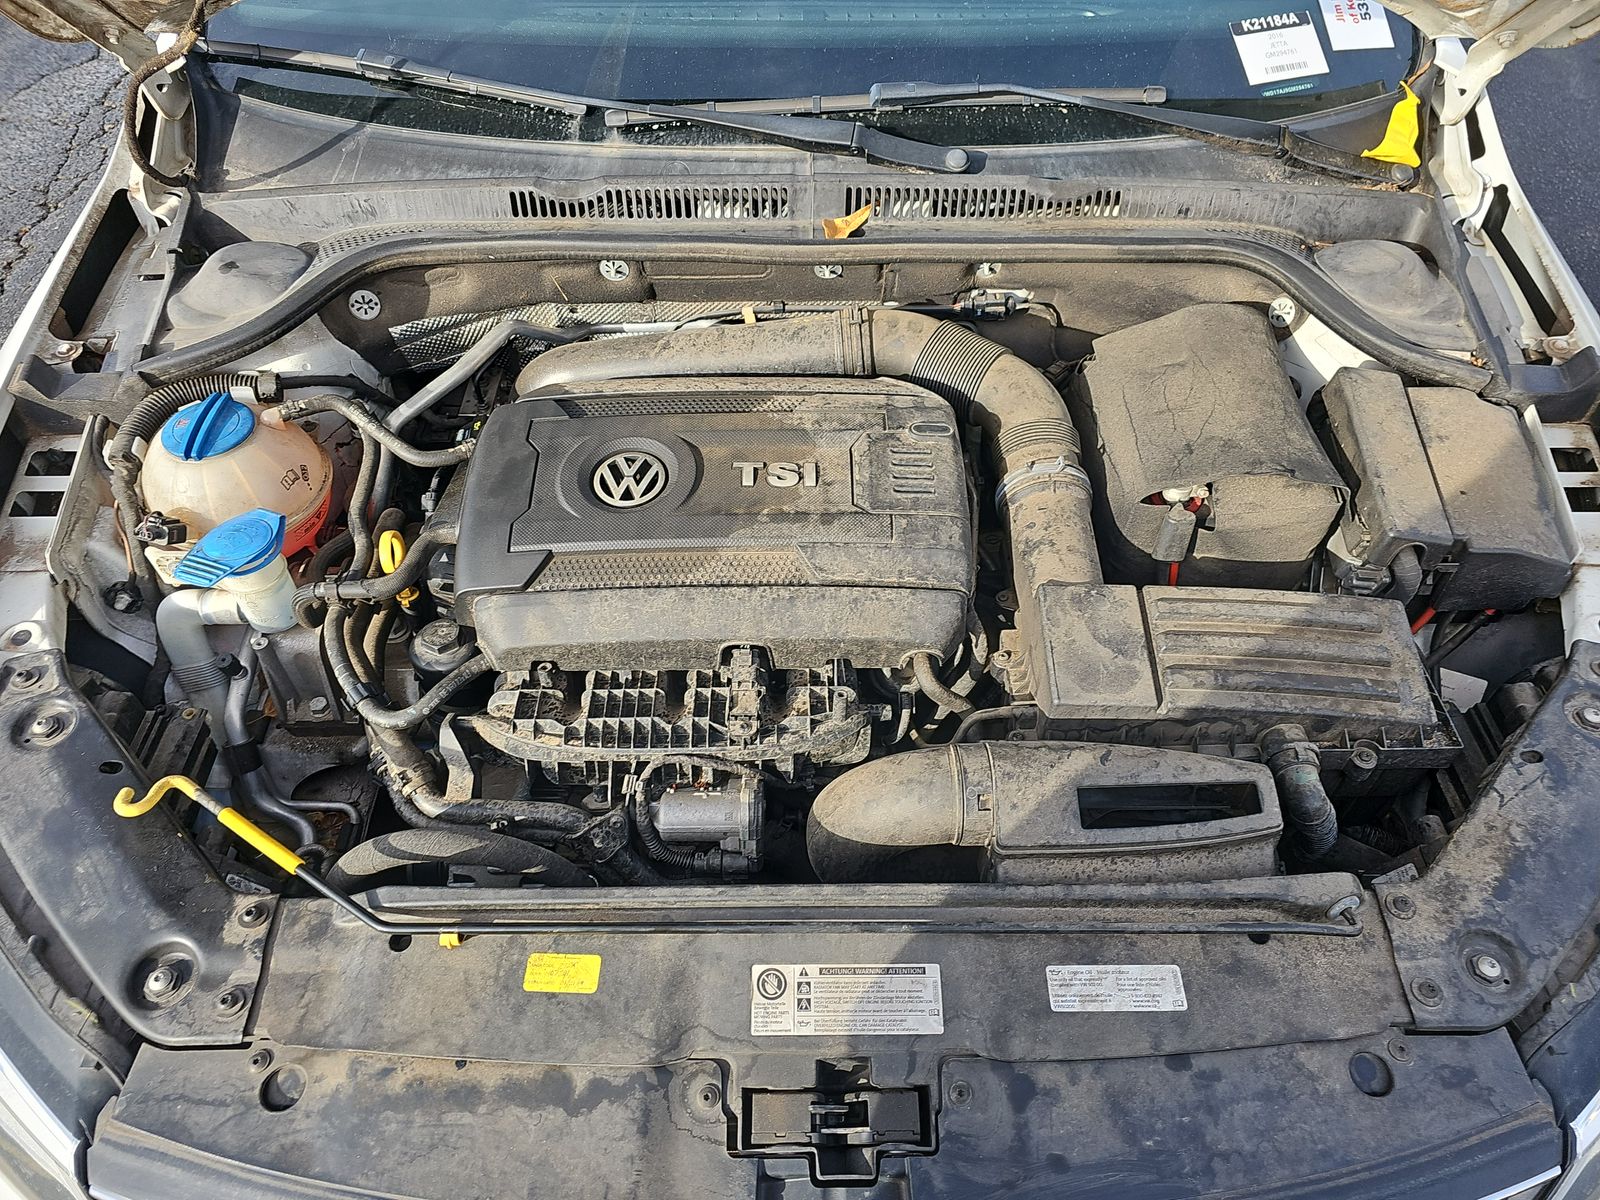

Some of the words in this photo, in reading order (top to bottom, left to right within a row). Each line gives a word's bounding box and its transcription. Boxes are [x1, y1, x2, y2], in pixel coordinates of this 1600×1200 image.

[1335, 4, 1346, 23] Jim
[1349, 13, 1360, 24] of
[1357, 0, 1372, 21] 53
[1240, 12, 1300, 32] K21184A
[1268, 32, 1284, 41] 2016
[1270, 41, 1289, 49] JETTA
[731, 460, 820, 488] TSI
